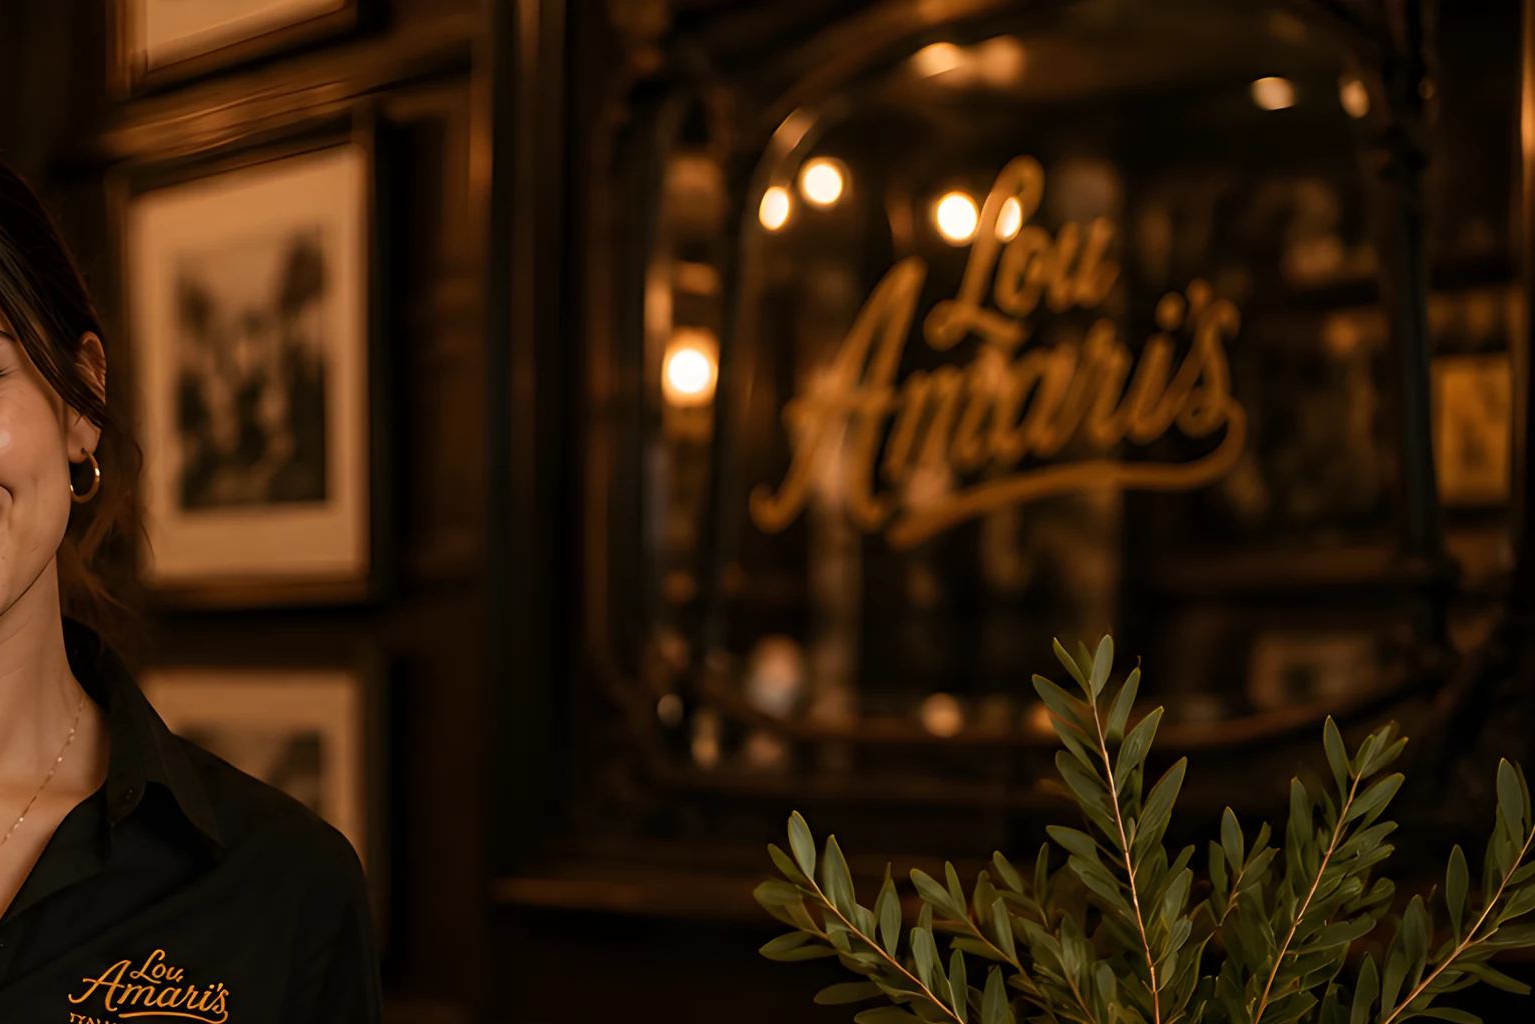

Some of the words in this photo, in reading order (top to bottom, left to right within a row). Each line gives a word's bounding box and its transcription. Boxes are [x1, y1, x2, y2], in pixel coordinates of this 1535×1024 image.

[924, 155, 1122, 350] Lou
[750, 256, 1248, 549] Amari's
[68, 959, 229, 1024] Amari's
[130, 949, 185, 984] Lou
